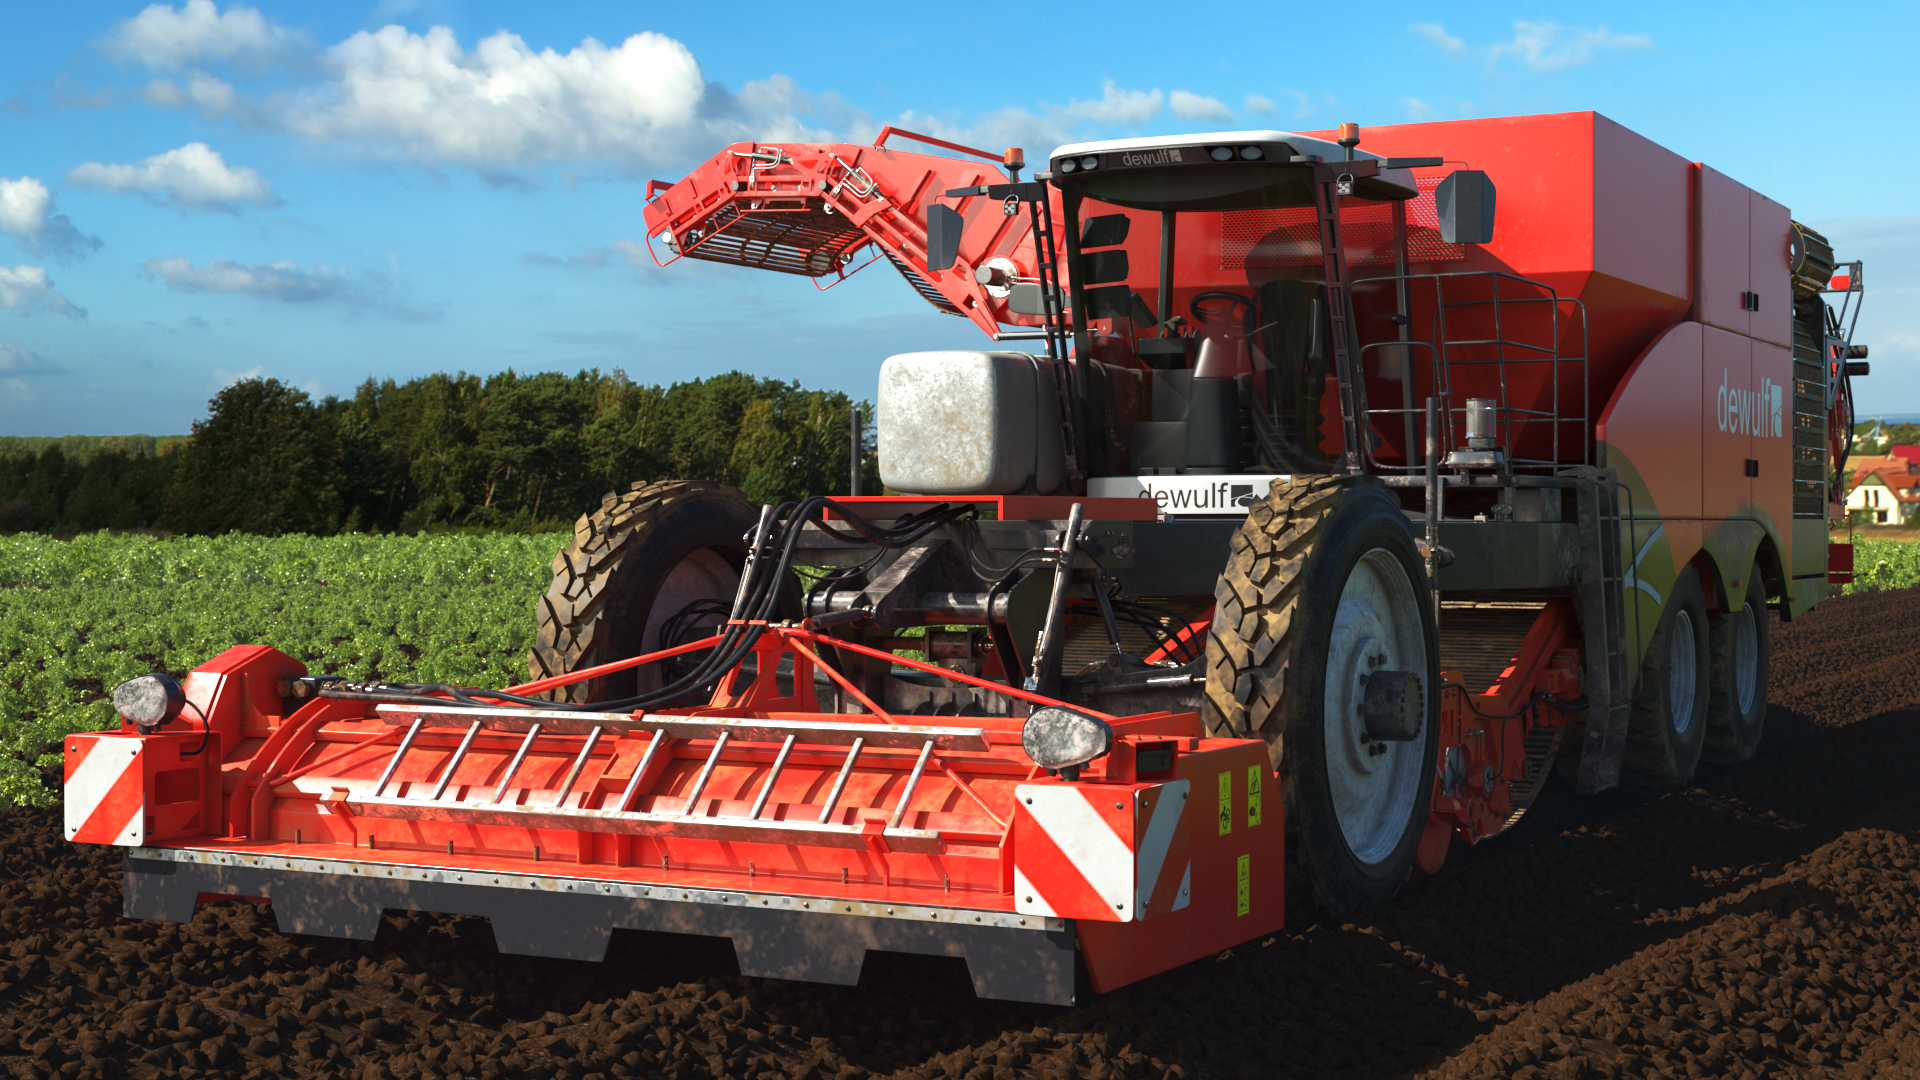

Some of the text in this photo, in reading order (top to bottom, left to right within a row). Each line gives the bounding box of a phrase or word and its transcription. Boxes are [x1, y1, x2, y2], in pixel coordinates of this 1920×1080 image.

[1122, 149, 1169, 166] dewulf
[1717, 368, 1771, 438] dewulf
[1139, 482, 1228, 508] dewulf
